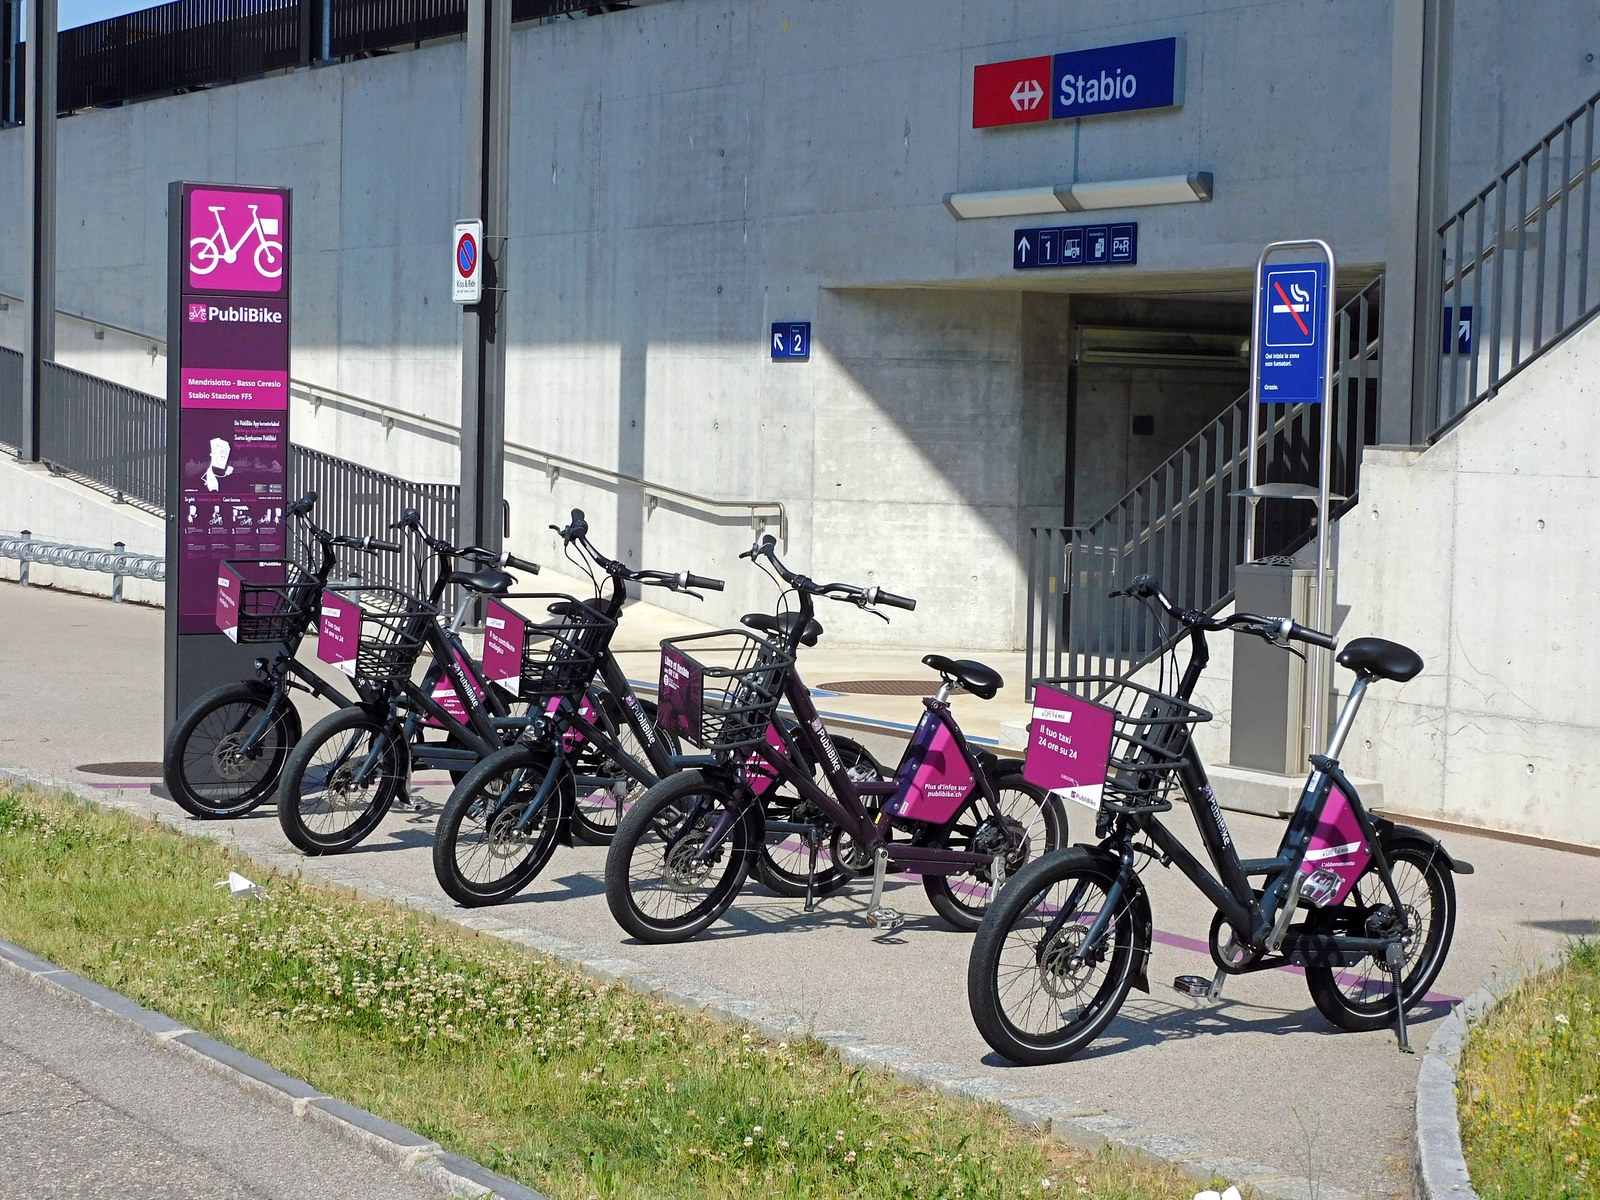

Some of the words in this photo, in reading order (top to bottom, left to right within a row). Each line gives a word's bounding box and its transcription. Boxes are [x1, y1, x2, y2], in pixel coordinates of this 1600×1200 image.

[1060, 67, 1137, 106] Stabio
[1045, 240, 1051, 260] 1
[1113, 240, 1129, 253] P+R
[468, 280, 476, 288] Ride
[208, 306, 282, 323] PubliBike
[794, 334, 802, 352] 2
[188, 378, 231, 387] Mendrisiotto
[236, 379, 256, 387] Basso
[257, 380, 282, 388] Ceresio
[188, 391, 210, 399] Stabio
[211, 391, 240, 400] Stazione
[457, 670, 479, 708] PubliBike
[632, 705, 656, 744] PubliBike
[1046, 727, 1057, 739] tuo
[1058, 732, 1072, 745] taxi
[817, 728, 841, 772] PubliBike
[1038, 736, 1047, 747] 24
[1047, 741, 1059, 752] ore
[1059, 746, 1068, 756] su
[1068, 749, 1078, 760] 24
[927, 790, 962, 798] publibike.ch
[937, 783, 957, 791] d'infos
[1208, 794, 1231, 846] PubliBike
